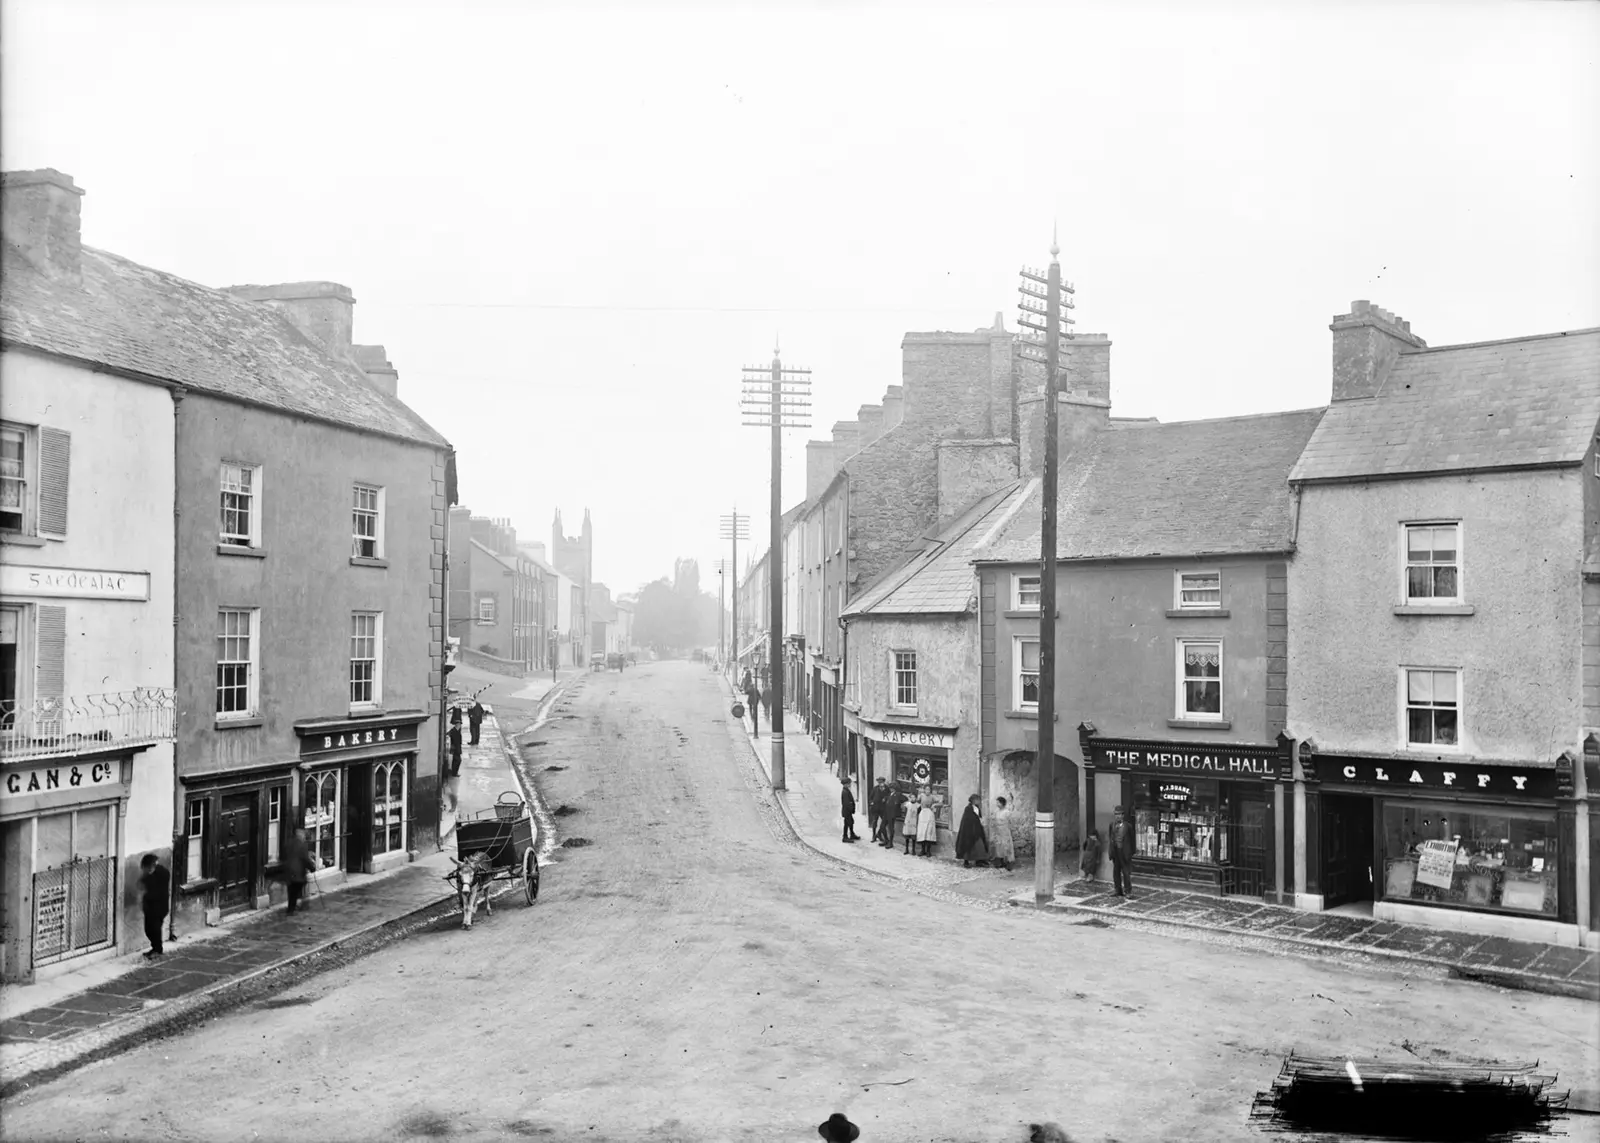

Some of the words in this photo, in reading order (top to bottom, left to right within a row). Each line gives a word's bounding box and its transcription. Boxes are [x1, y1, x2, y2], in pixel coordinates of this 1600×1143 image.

[324, 729, 398, 748] BAKERY
[881, 728, 946, 746] RAFTERY
[1106, 750, 1140, 766] THE
[1146, 752, 1226, 772] MEDICAL
[1229, 757, 1275, 774] HALL
[69, 766, 83, 787] &
[1343, 766, 1528, 789] CLAFFY
